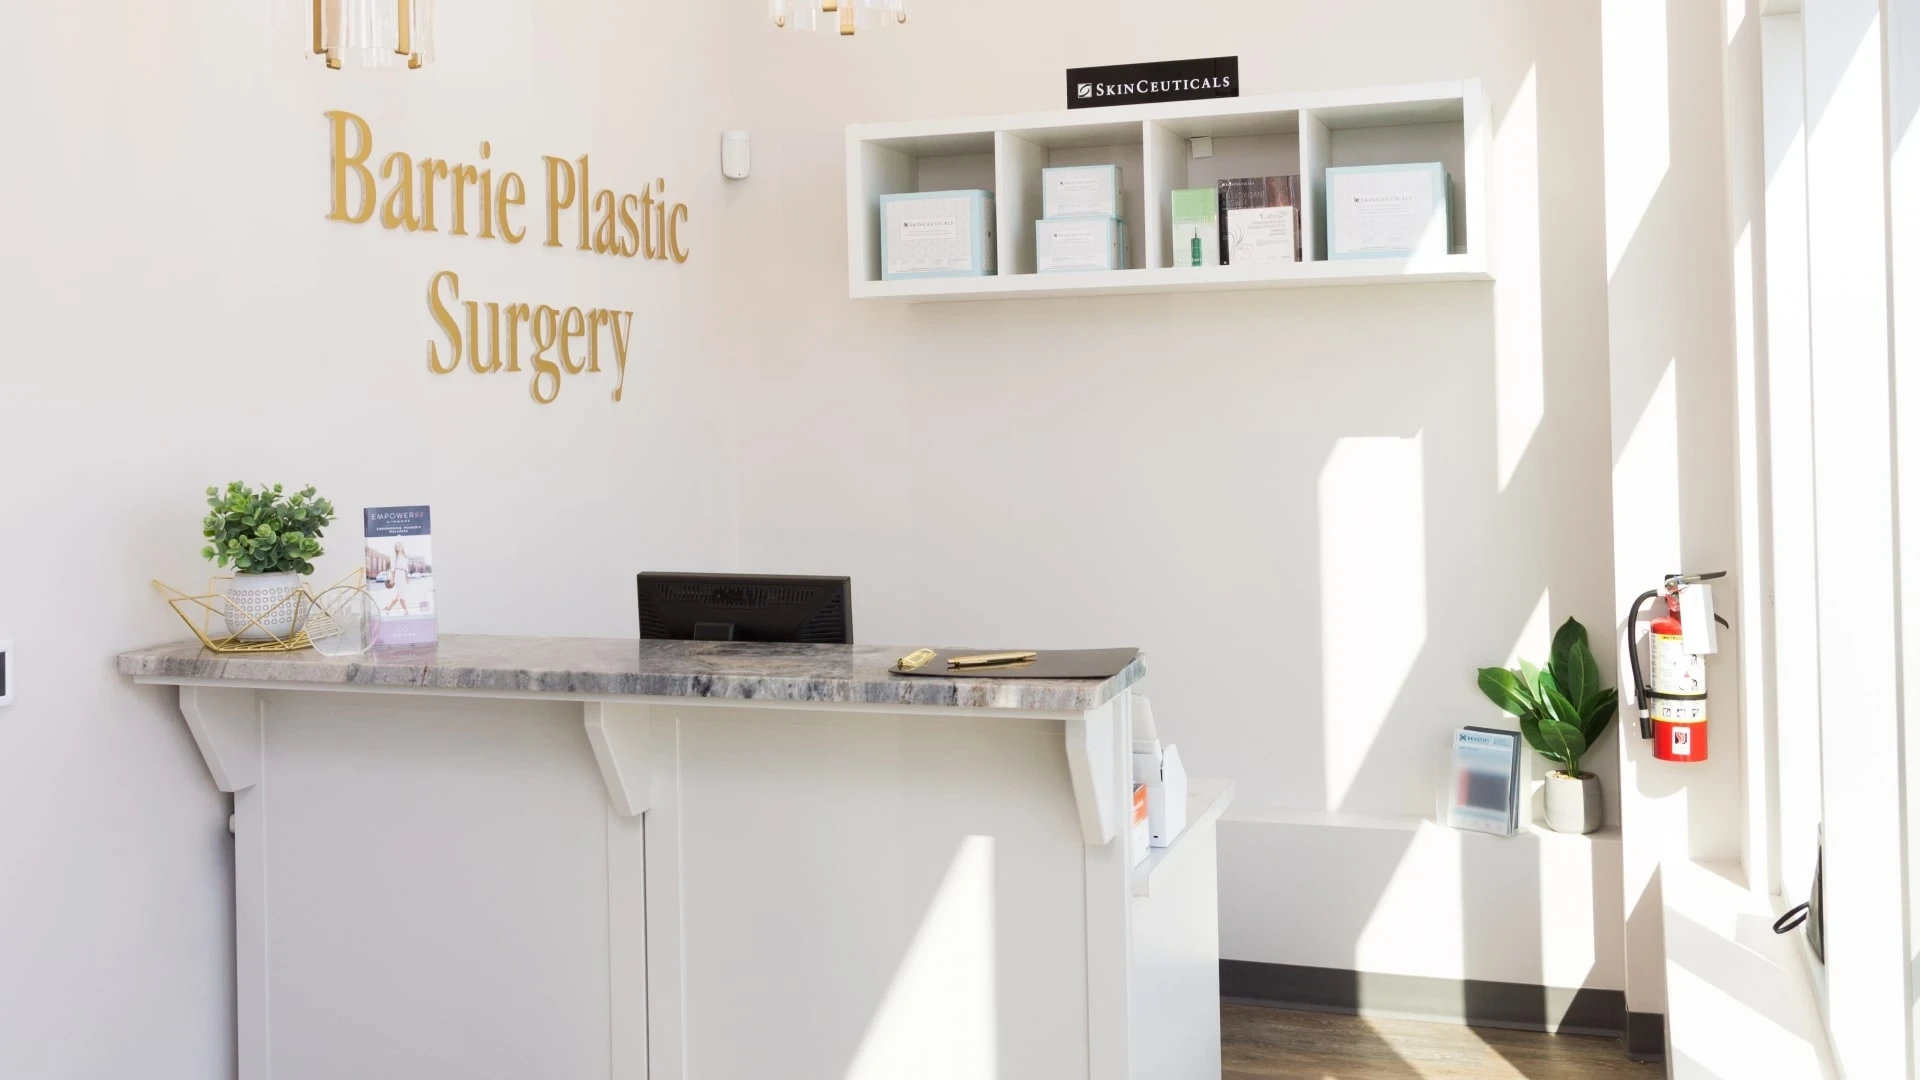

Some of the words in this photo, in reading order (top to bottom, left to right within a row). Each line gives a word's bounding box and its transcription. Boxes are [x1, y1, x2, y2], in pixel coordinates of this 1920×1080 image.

[324, 110, 526, 244] Barrie
[541, 153, 689, 264] Plastic
[427, 270, 634, 404] Surgery
